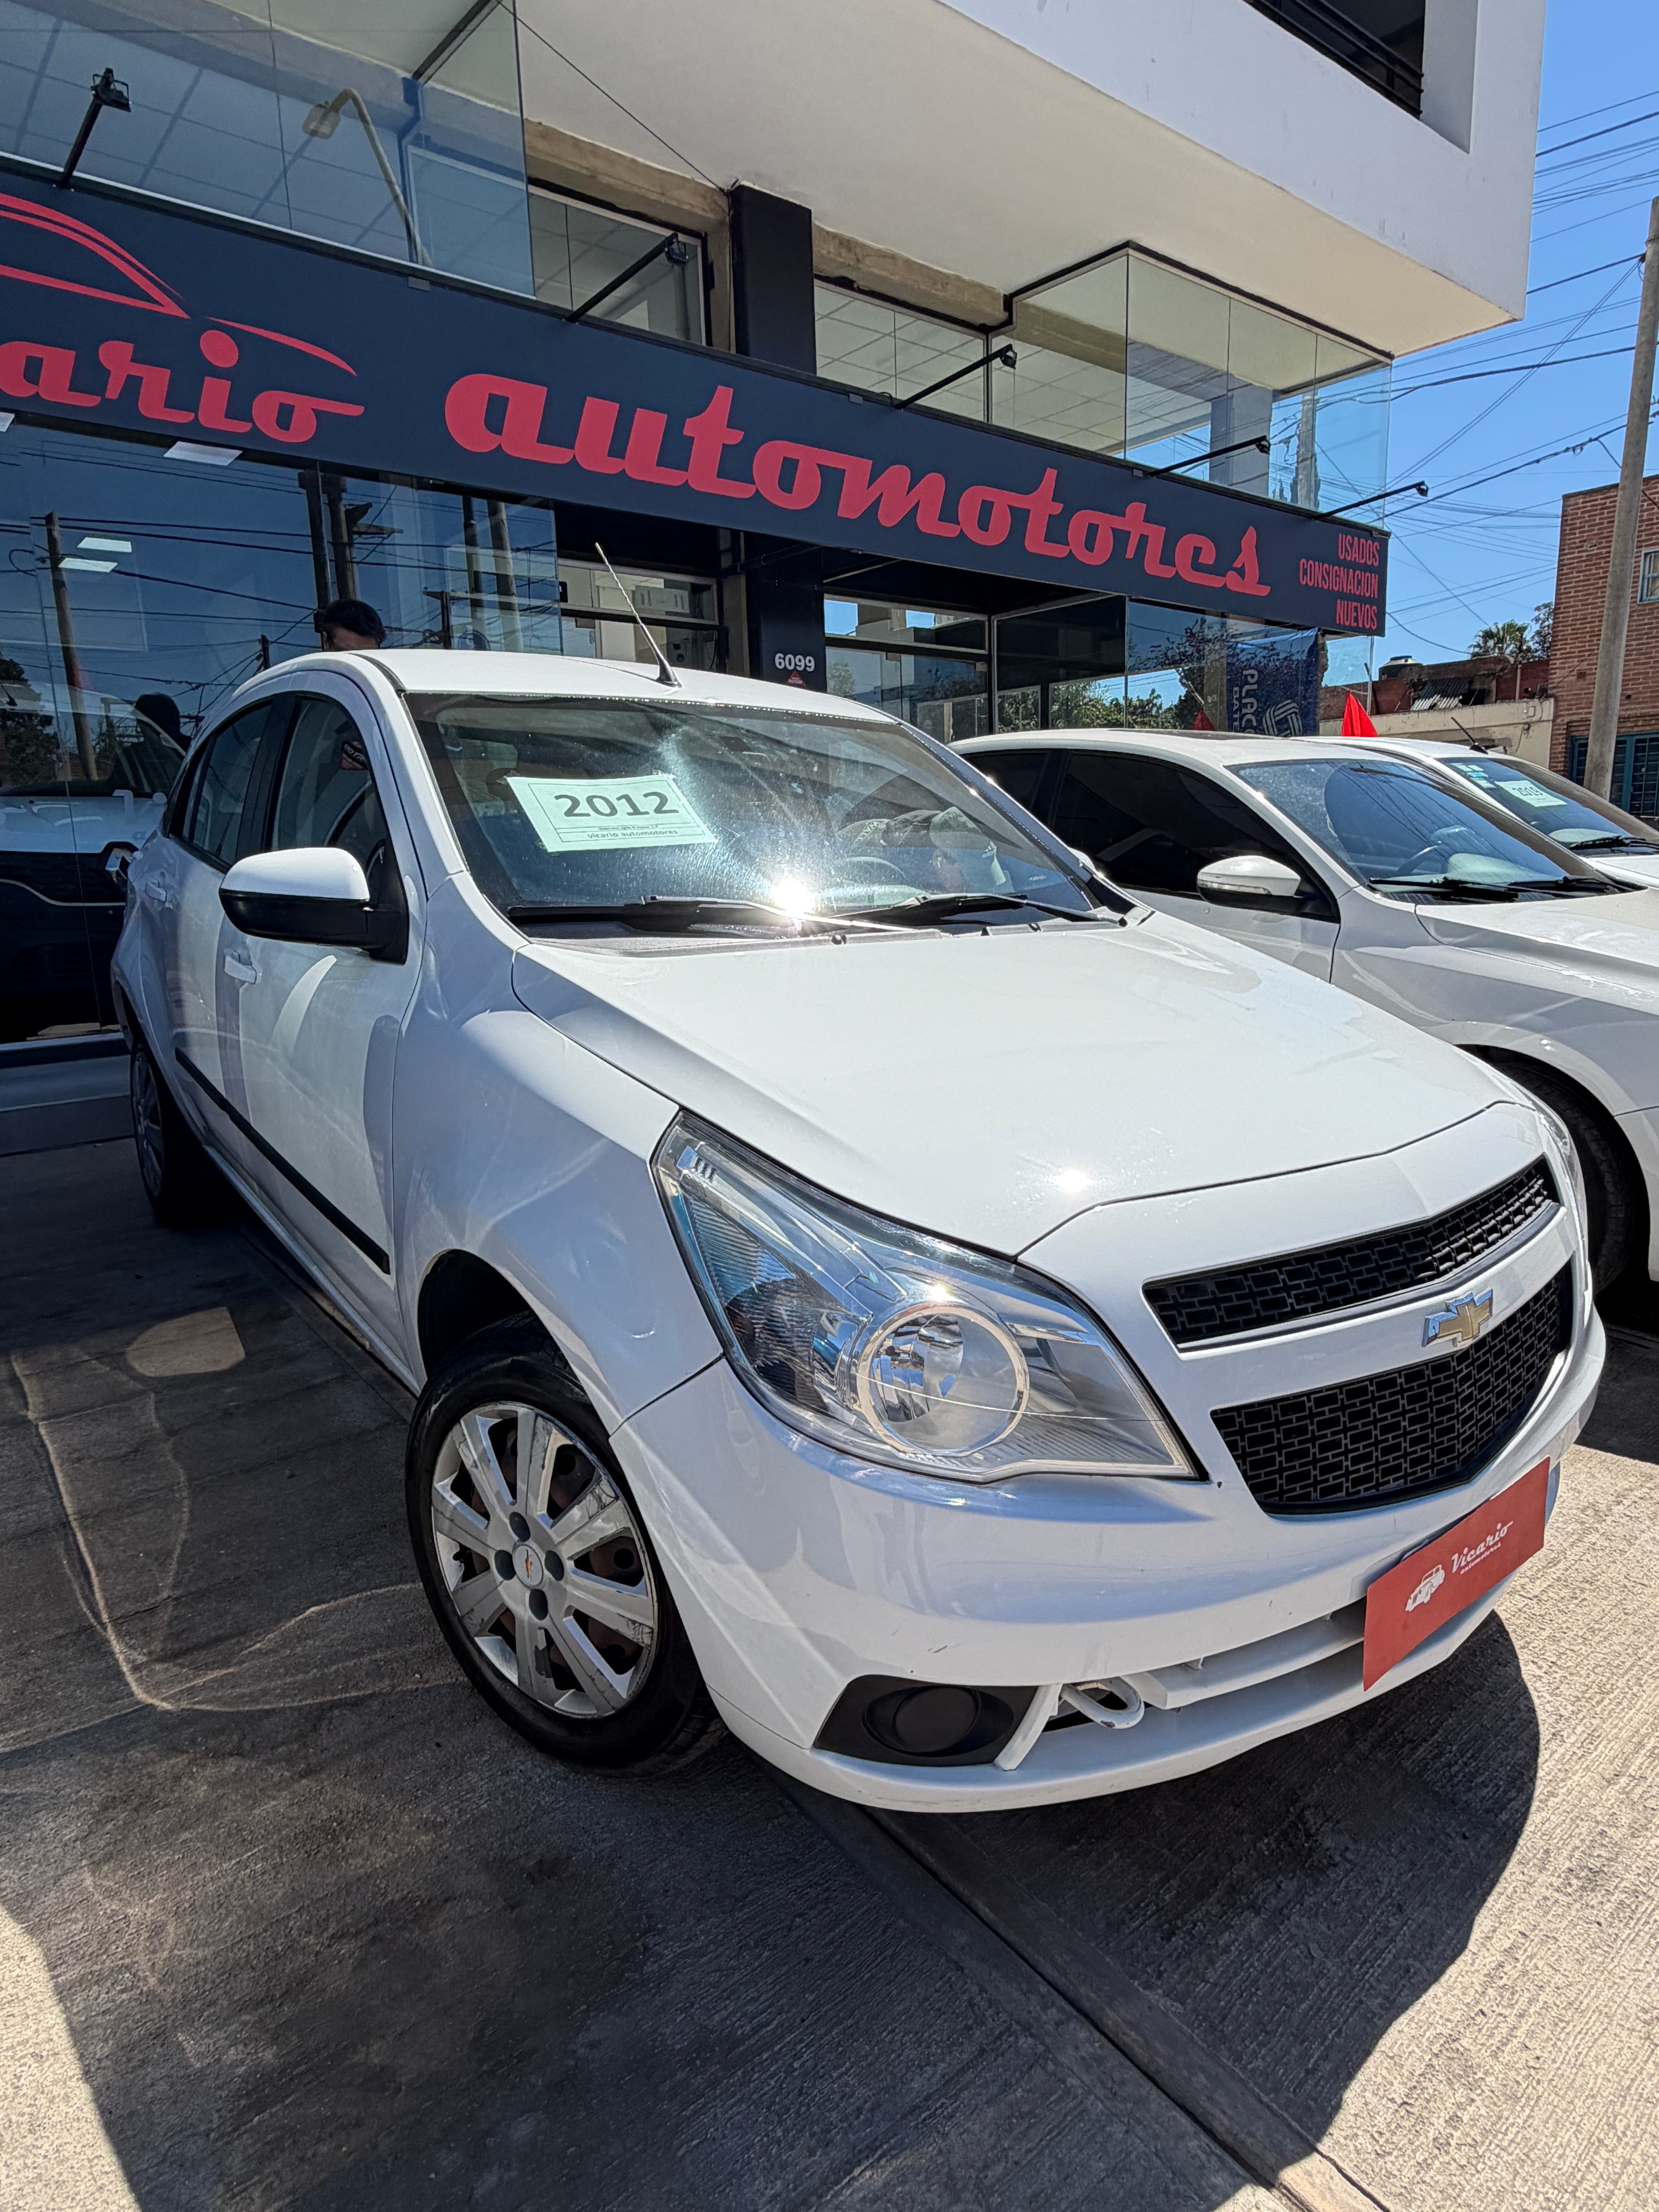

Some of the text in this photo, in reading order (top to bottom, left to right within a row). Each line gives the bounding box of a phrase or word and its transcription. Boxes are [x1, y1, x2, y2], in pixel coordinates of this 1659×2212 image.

[0, 330, 1271, 596] ario automotores
[1338, 533, 1379, 567] USADOS
[1299, 558, 1378, 598] CONSIGNACION
[1336, 599, 1377, 631] NUEVOS
[775, 653, 815, 672] 6099
[554, 791, 679, 817] 2012
[1452, 1521, 1513, 1573] Vicario
